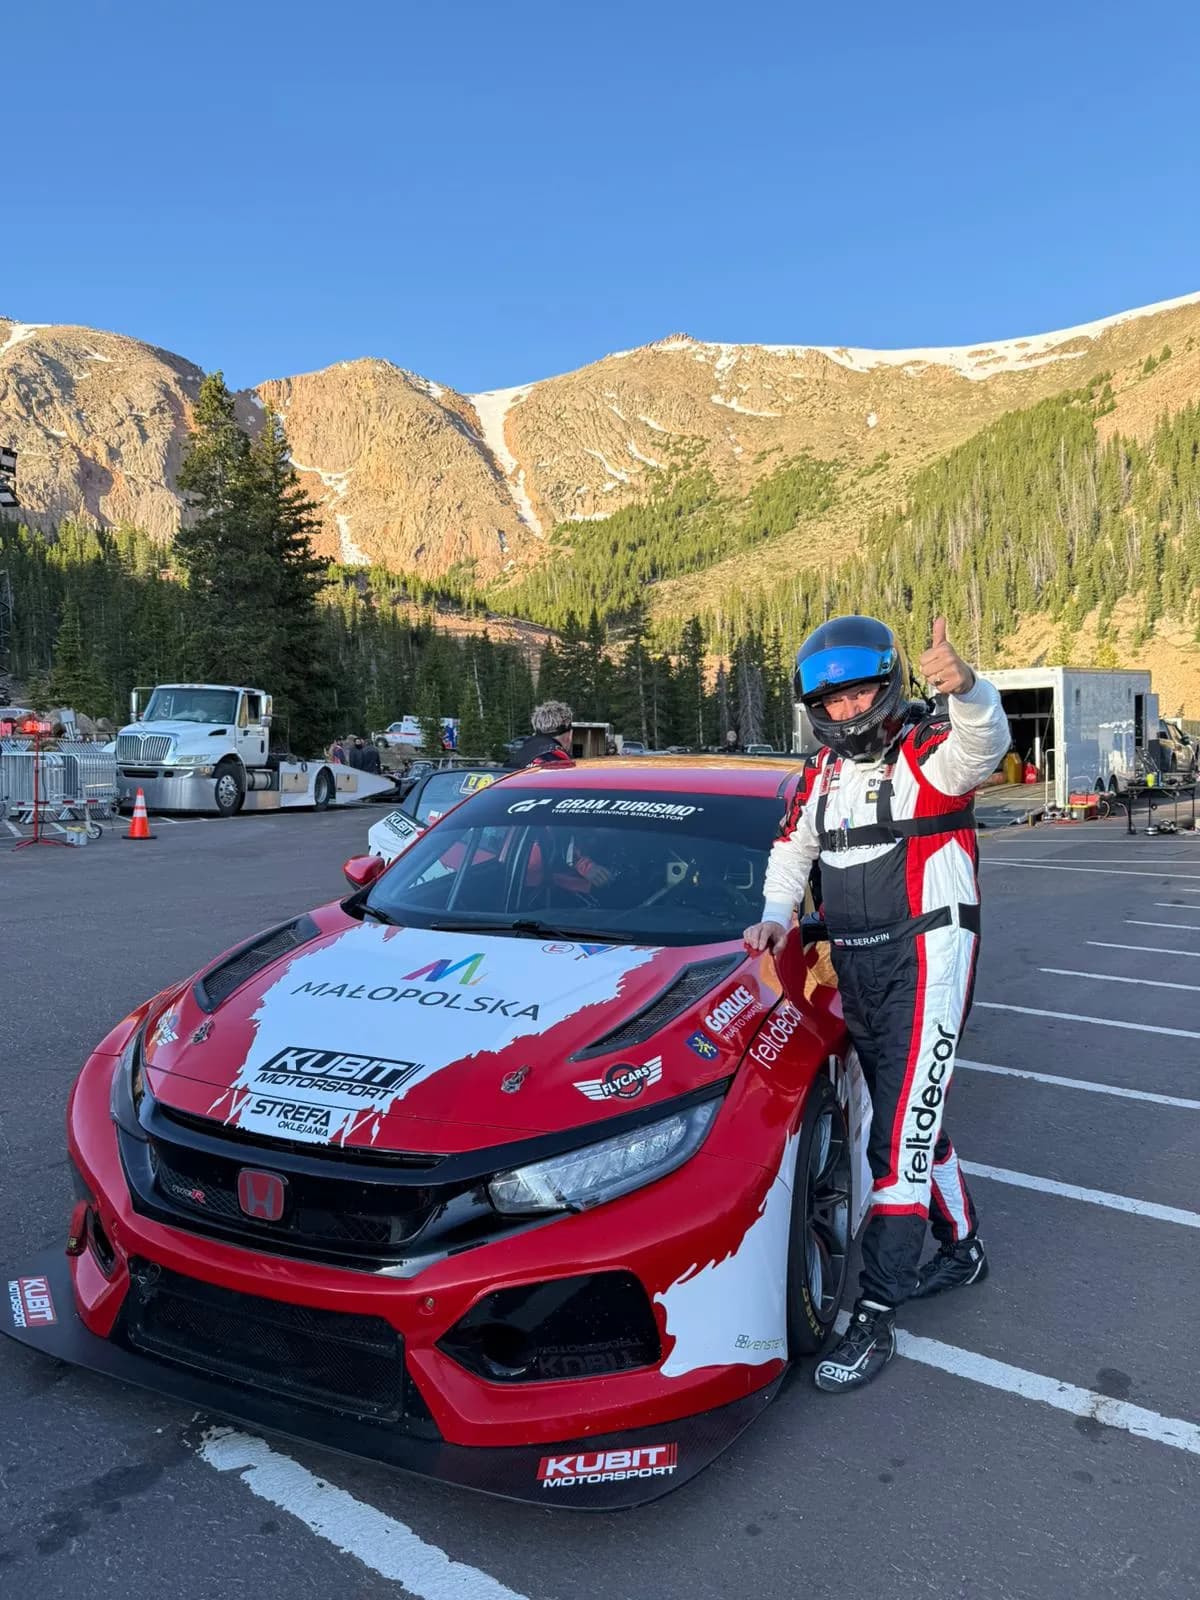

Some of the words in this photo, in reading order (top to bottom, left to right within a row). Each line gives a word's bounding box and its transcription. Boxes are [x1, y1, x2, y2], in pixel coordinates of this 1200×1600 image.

[555, 798, 604, 810] GRAN
[610, 800, 697, 817] TURISMO
[592, 809, 628, 817] DRIVING
[630, 811, 684, 822] SIMULATOR
[388, 814, 415, 836] KUBIT
[290, 981, 540, 1022] MAŁOPOLSKA
[705, 985, 754, 1031] GORLICE
[749, 999, 804, 1070] feltdecor
[270, 1050, 408, 1088] KUBIT
[603, 1066, 650, 1096] FLYCARS
[254, 1073, 395, 1100] MOTORSPORT
[251, 1099, 331, 1127] STREFA
[904, 1023, 956, 1184] feltdecor
[278, 1121, 328, 1137] OKLEJANIA
[8, 1280, 27, 1328] MOTORSPORT
[23, 1278, 53, 1321] KUBIT
[546, 1446, 667, 1476] KUBIT
[543, 1465, 677, 1488] MOTORSPORT
